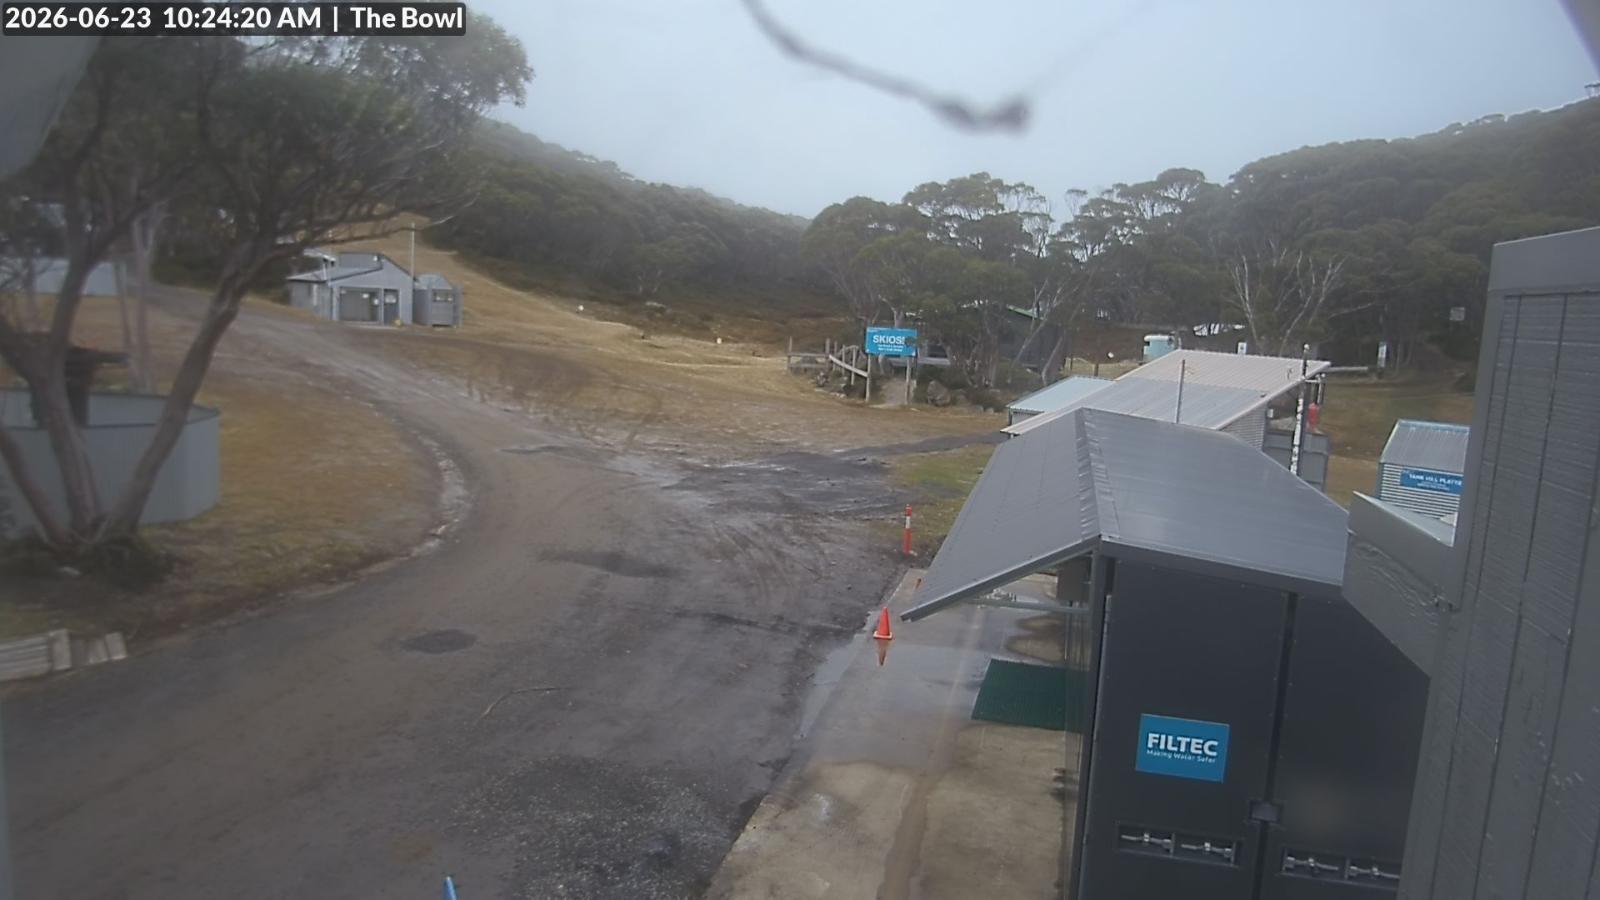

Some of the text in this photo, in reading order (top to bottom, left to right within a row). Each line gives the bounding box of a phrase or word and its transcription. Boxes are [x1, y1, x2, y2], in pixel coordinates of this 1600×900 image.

[1147, 732, 1219, 757] FILTEC
[1146, 749, 1173, 759] Making
[1173, 753, 1195, 761] Water
